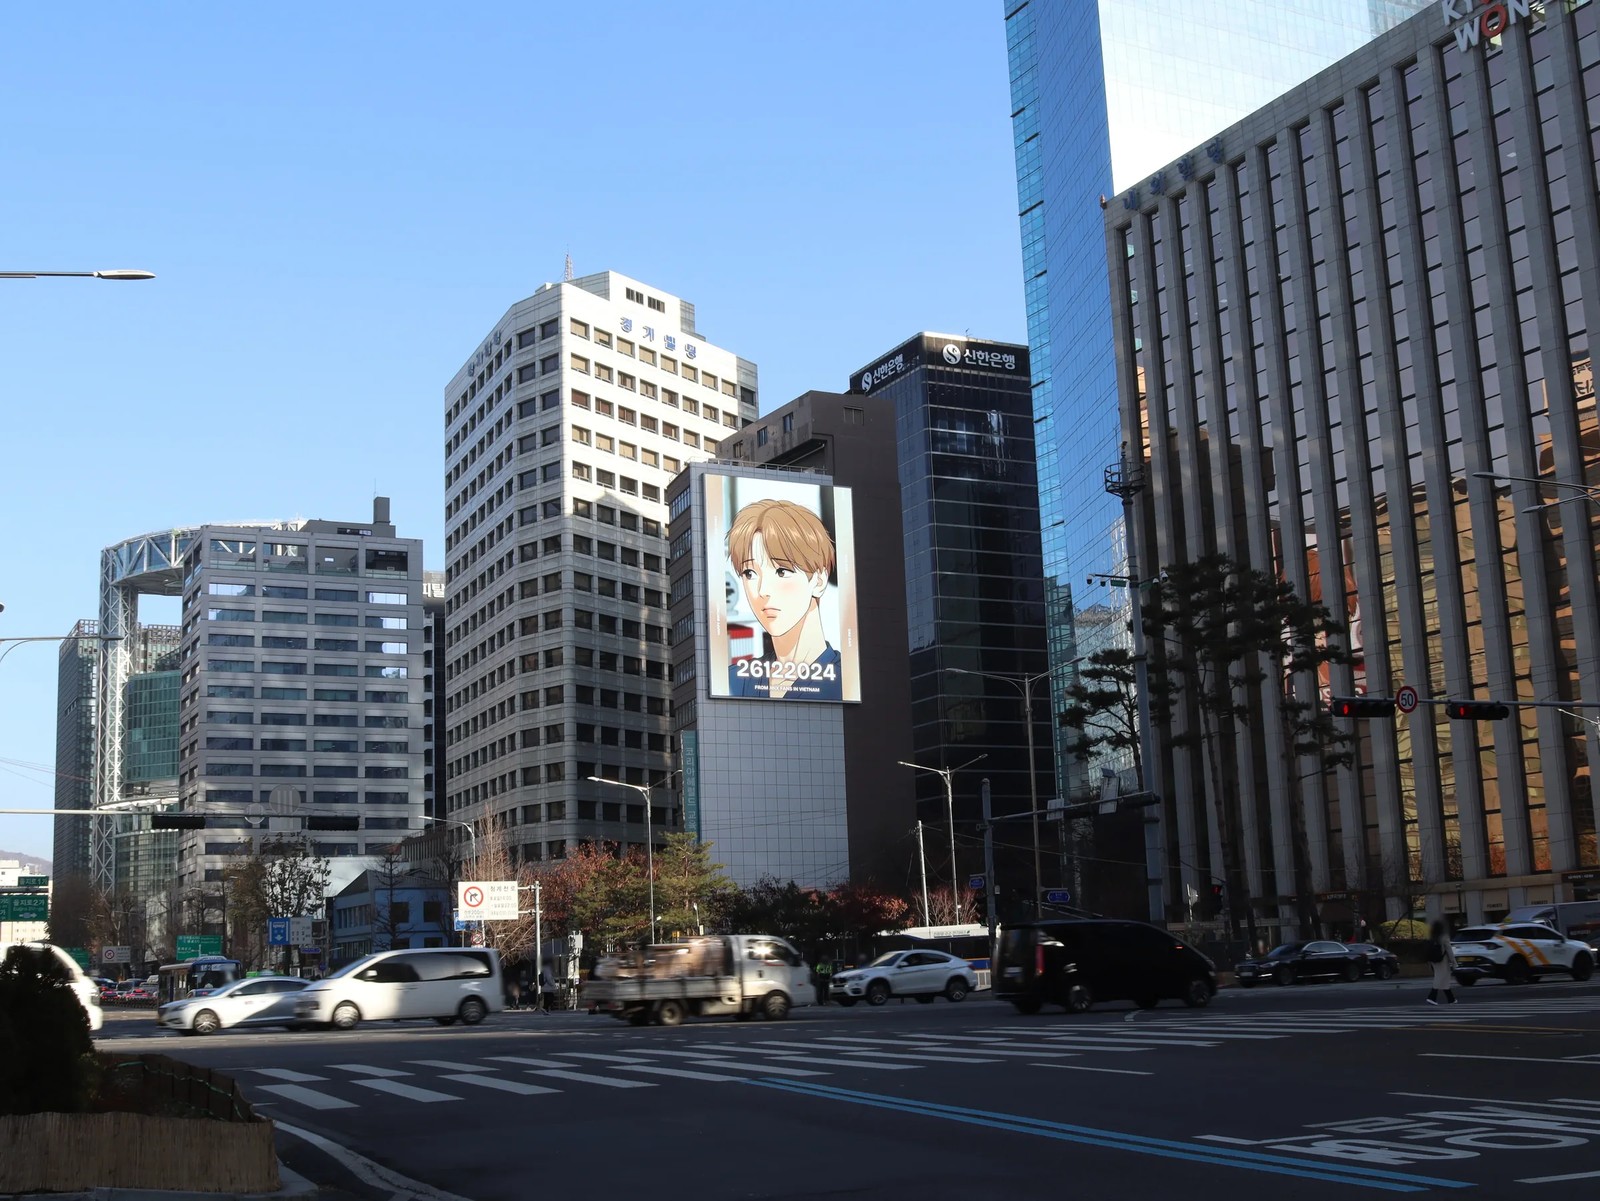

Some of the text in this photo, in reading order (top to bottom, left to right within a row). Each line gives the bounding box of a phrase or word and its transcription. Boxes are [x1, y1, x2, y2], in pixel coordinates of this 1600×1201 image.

[1454, 0, 1530, 53] WON
[872, 353, 904, 384] 신한은행
[963, 349, 1016, 370] 신한은행
[736, 659, 836, 681] 26122024
[1400, 693, 1414, 707] 50
